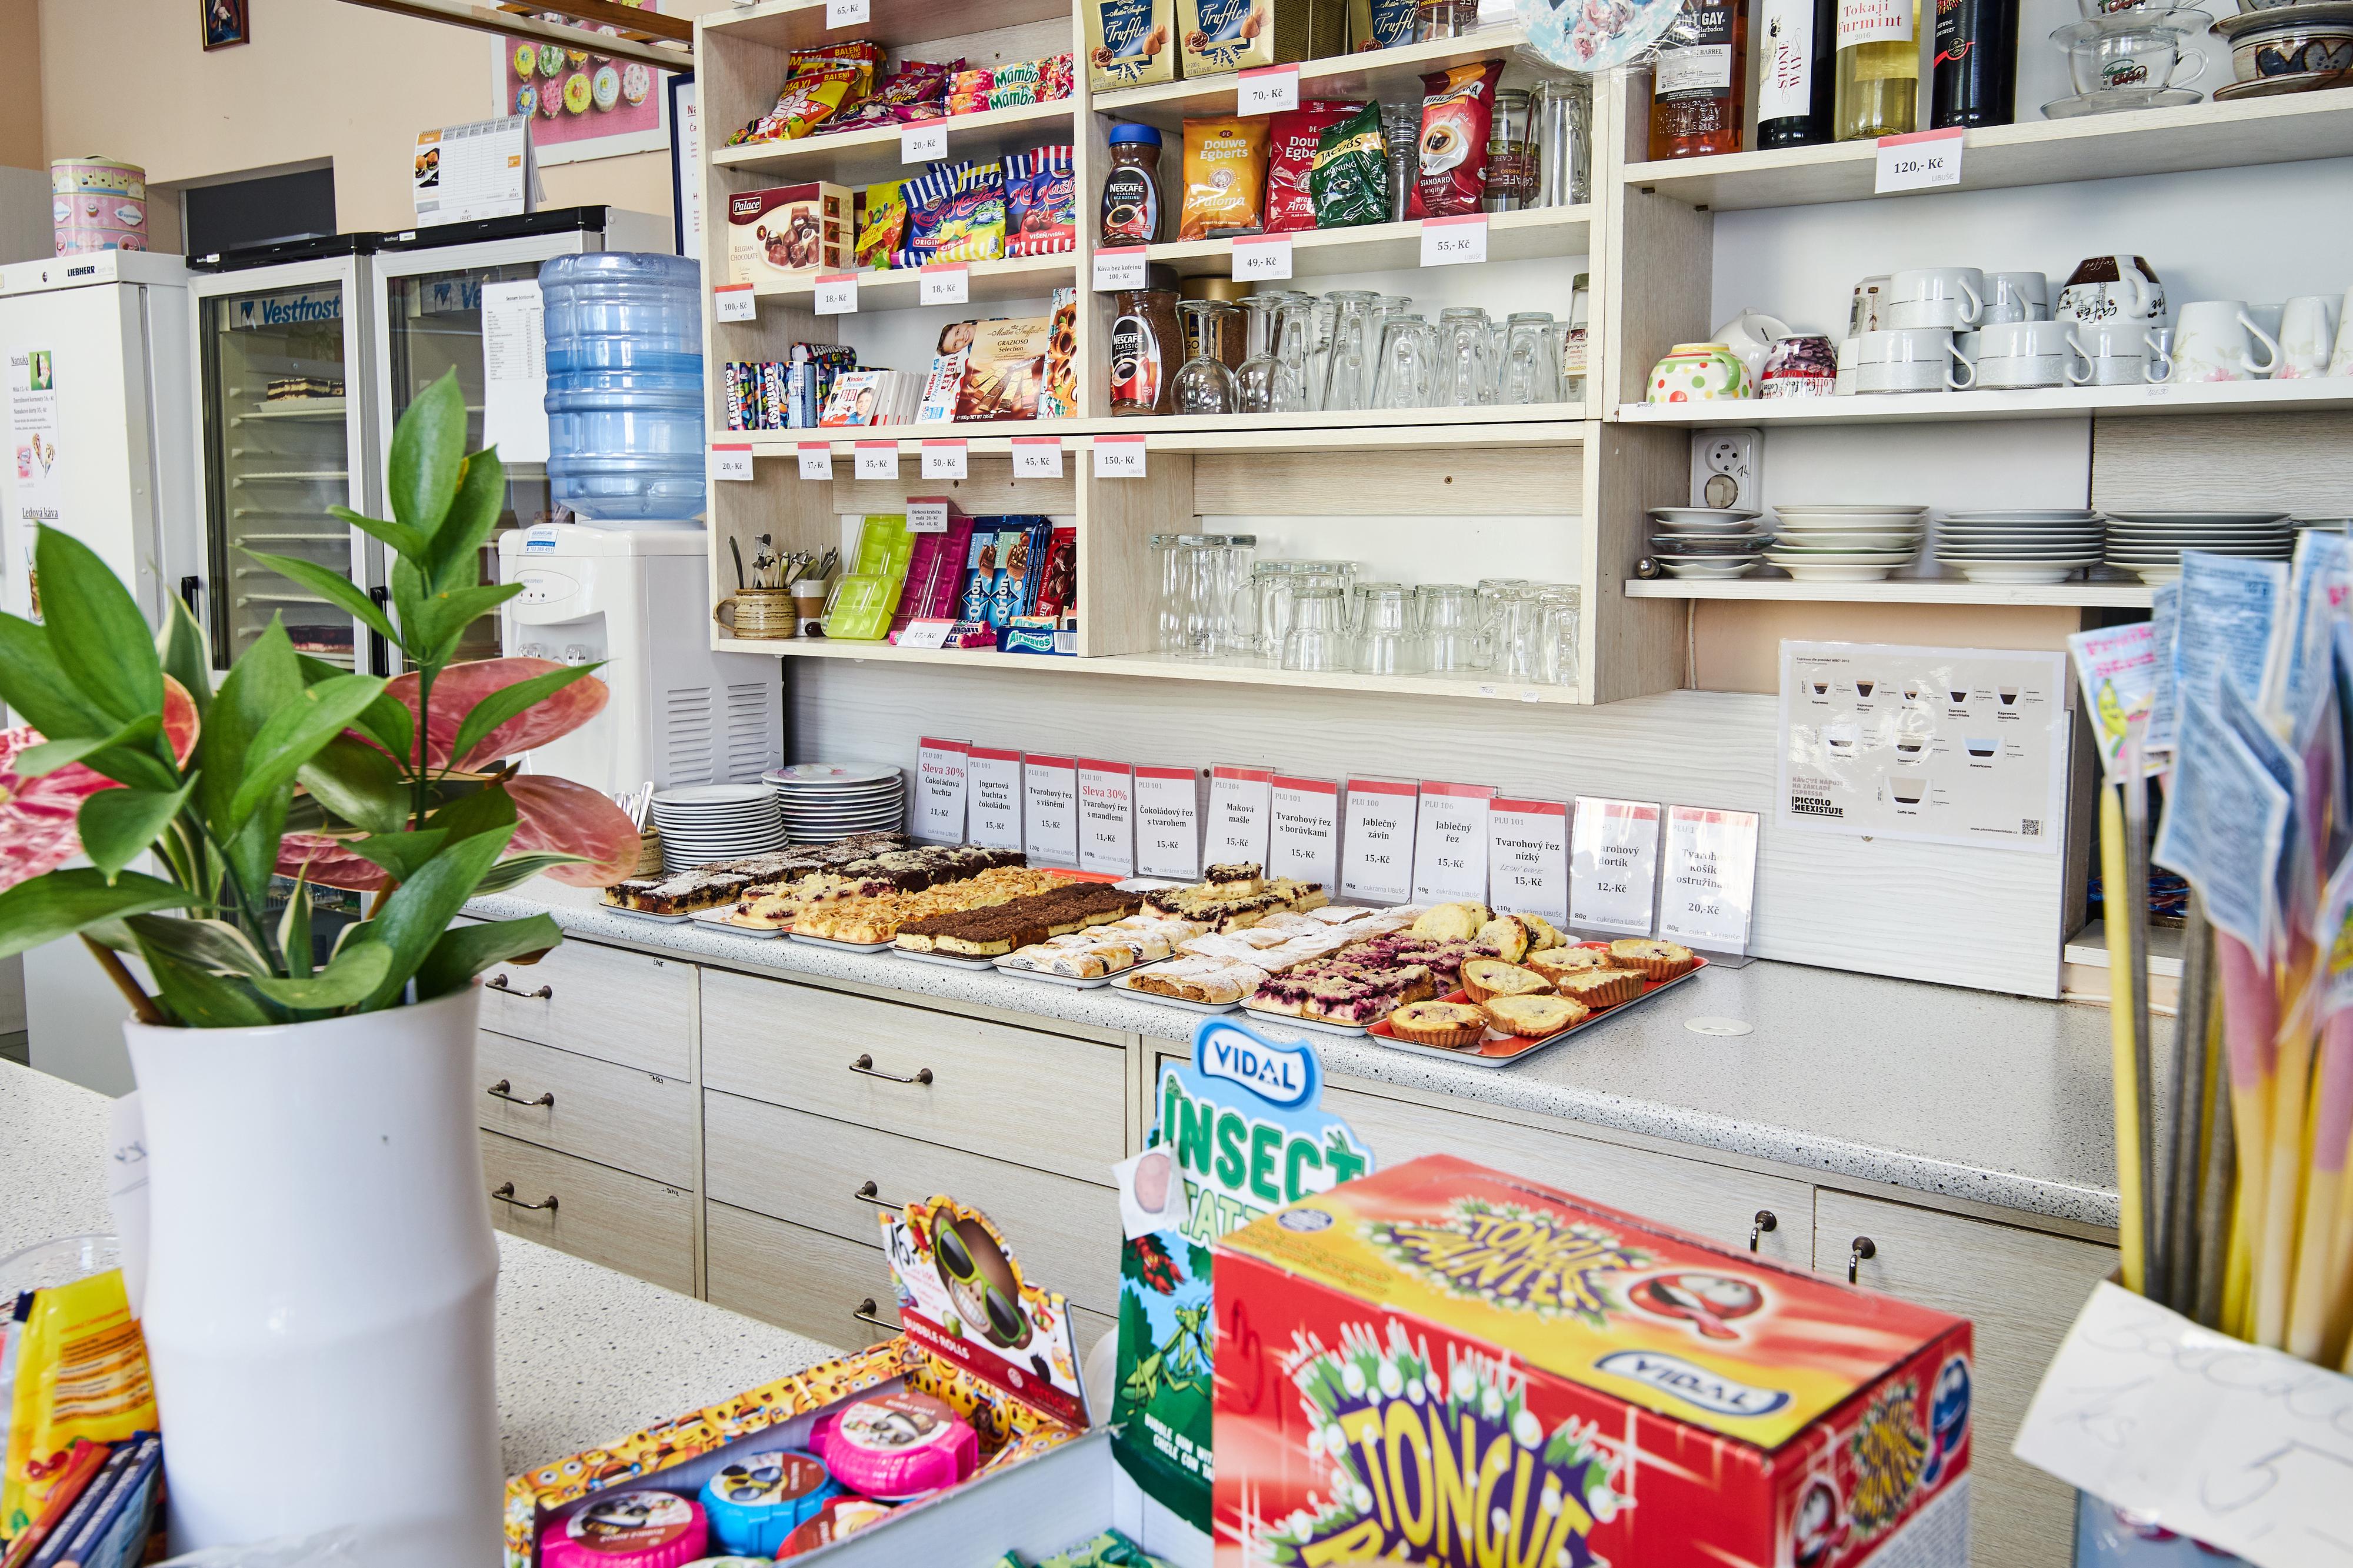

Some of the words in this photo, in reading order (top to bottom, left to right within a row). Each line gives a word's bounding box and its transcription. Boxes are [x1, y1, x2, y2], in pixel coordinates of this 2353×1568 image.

[837, 6, 849, 15] 65,-
[1844, 0, 1889, 17] Tokaji
[1702, 12, 1724, 25] GAY
[1838, 14, 1902, 36] Furmint
[835, 44, 861, 56] BALENÍ
[1777, 41, 1789, 89] STONE
[824, 70, 850, 81] BALENÍ
[1789, 55, 1802, 87] WAY
[994, 68, 1039, 89] Mambo
[1252, 91, 1269, 101] 70,-
[1272, 89, 1282, 98] Kč
[1458, 112, 1469, 122] silná
[913, 141, 925, 149] 20,-
[1204, 138, 1247, 151] Douwe
[1200, 149, 1248, 162] Egberts
[1320, 138, 1361, 165] JACOBS
[1894, 161, 1924, 174] 120,-
[1928, 157, 1944, 169] Kč
[1420, 176, 1451, 187] STANDARD
[1931, 173, 1954, 182] LIBUŠE
[1109, 181, 1144, 193] NESCAFÉ
[1424, 184, 1447, 195] original
[734, 199, 761, 212] Palace
[1029, 231, 1065, 239] VIŠEŇ/VIŠŇA
[1437, 241, 1455, 251] 55,-
[1458, 239, 1470, 249] Kč
[730, 252, 758, 261] CHOCOLATE
[1247, 258, 1263, 267] 49,-
[1266, 257, 1277, 266] Kč
[67, 266, 95, 277] LIEBHERR
[932, 285, 945, 293] 18,-
[946, 284, 955, 292] Kč
[262, 295, 341, 324] Vestfrost
[11, 355, 29, 366] Nanuky
[765, 368, 781, 424] LENTILKY
[933, 459, 945, 468] 50,-
[947, 458, 955, 466] Kč
[1025, 458, 1039, 466] 45,-
[1041, 457, 1050, 465] Kč
[1105, 456, 1123, 465] 150,-
[1126, 456, 1135, 464] Kč
[1737, 465, 1749, 478] 14
[22, 507, 42, 518] Ledová
[44, 507, 58, 518] káva
[996, 577, 1009, 618] Orion
[1009, 630, 1051, 646] Airwaves
[922, 763, 944, 775] Sleva
[945, 766, 964, 778] 30%
[925, 776, 959, 788] Čokoládová
[979, 779, 1009, 790] Jogurtová
[931, 788, 952, 797] buchta
[981, 790, 1002, 800] buchta
[1029, 787, 1061, 799] Tvarohový
[1062, 790, 1072, 799] řez
[1082, 785, 1105, 797] Sleva
[1106, 789, 1127, 800] 30%
[978, 800, 1011, 810] čokoládou
[1041, 798, 1065, 808] višněmi
[1083, 799, 1116, 811] Tvarohový
[1117, 803, 1128, 812] řez
[1440, 802, 1454, 810] 106
[1795, 797, 1831, 806] PICCOLO
[930, 808, 949, 818] 11,-Kč
[1139, 805, 1181, 816] Čokoládový
[1182, 808, 1193, 817] řez
[1226, 803, 1254, 813] Maková
[1794, 804, 1844, 815] NEEXISTUJE
[1092, 812, 1123, 822] mandlemi
[1152, 818, 1187, 827] tvarohem
[1228, 814, 1249, 824] mašle
[1276, 812, 1317, 825] Tvarohový
[1318, 817, 1331, 826] řez
[985, 821, 1005, 830] 15,-Kč
[1042, 820, 1061, 829] 15,-Kč
[1362, 818, 1397, 829] Jablečný
[1436, 820, 1472, 833] Jablečný
[1285, 825, 1327, 838] borůvkami
[1368, 830, 1389, 840] závin
[1096, 833, 1115, 843] 11,-Kč
[1226, 837, 1248, 847] 15,-Kč
[1446, 833, 1459, 843] řez
[1156, 840, 1178, 849] 15,-Kč
[1495, 837, 1543, 851] Tvarohový
[1545, 841, 1559, 851] řez
[1291, 849, 1315, 859] 15,-Kč
[1365, 854, 1390, 864] 15,-Kč
[1515, 852, 1539, 863] nízký
[1438, 858, 1464, 868] 15,-Kč
[1598, 856, 1628, 868] dortík
[1689, 863, 1717, 875] košík
[1514, 876, 1542, 887] 15,-Kč
[1387, 886, 1405, 895] LIBUŠE
[1597, 882, 1627, 893] 12,-Kč
[1496, 905, 1511, 913] 110g
[1688, 902, 1719, 915] 20,-Kč
[1575, 912, 1587, 920] 80g
[1597, 916, 1624, 925] cukrárna
[1625, 917, 1646, 927] LIBUŠE
[1667, 924, 1679, 933] 80g
[1214, 1040, 1297, 1092] VIDAL
[1163, 1073, 1365, 1205] INSECT
[903, 1316, 941, 1345] BUBBLE
[941, 1334, 970, 1360] ROLLS
[1339, 1399, 1594, 1568] TONGUE
